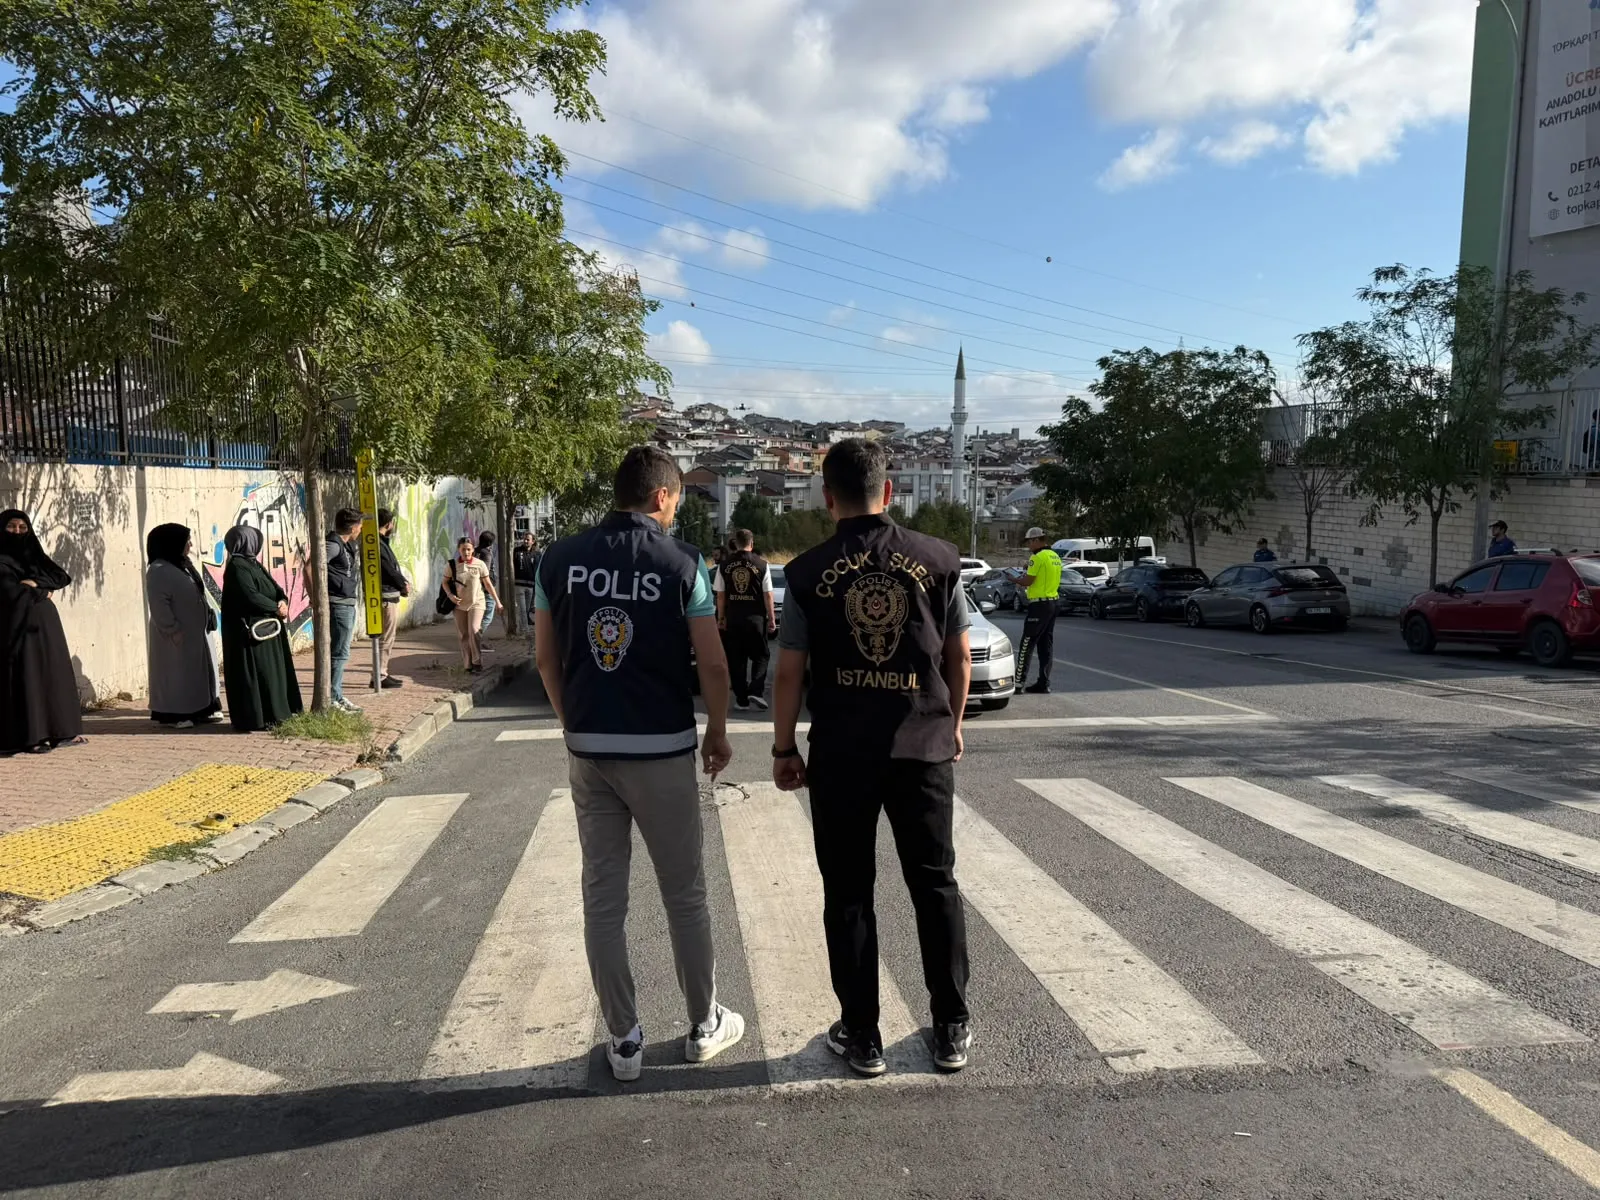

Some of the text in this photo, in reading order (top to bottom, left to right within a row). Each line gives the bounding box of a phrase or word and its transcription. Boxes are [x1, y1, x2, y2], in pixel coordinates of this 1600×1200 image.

[1552, 33, 1591, 54] TOPKAPI
[1546, 86, 1597, 111] ANADOLU
[1568, 182, 1591, 198] 0212
[816, 550, 875, 598] ÇOCUK
[858, 576, 892, 588] POLİS
[836, 667, 921, 690] İSTANBUL
